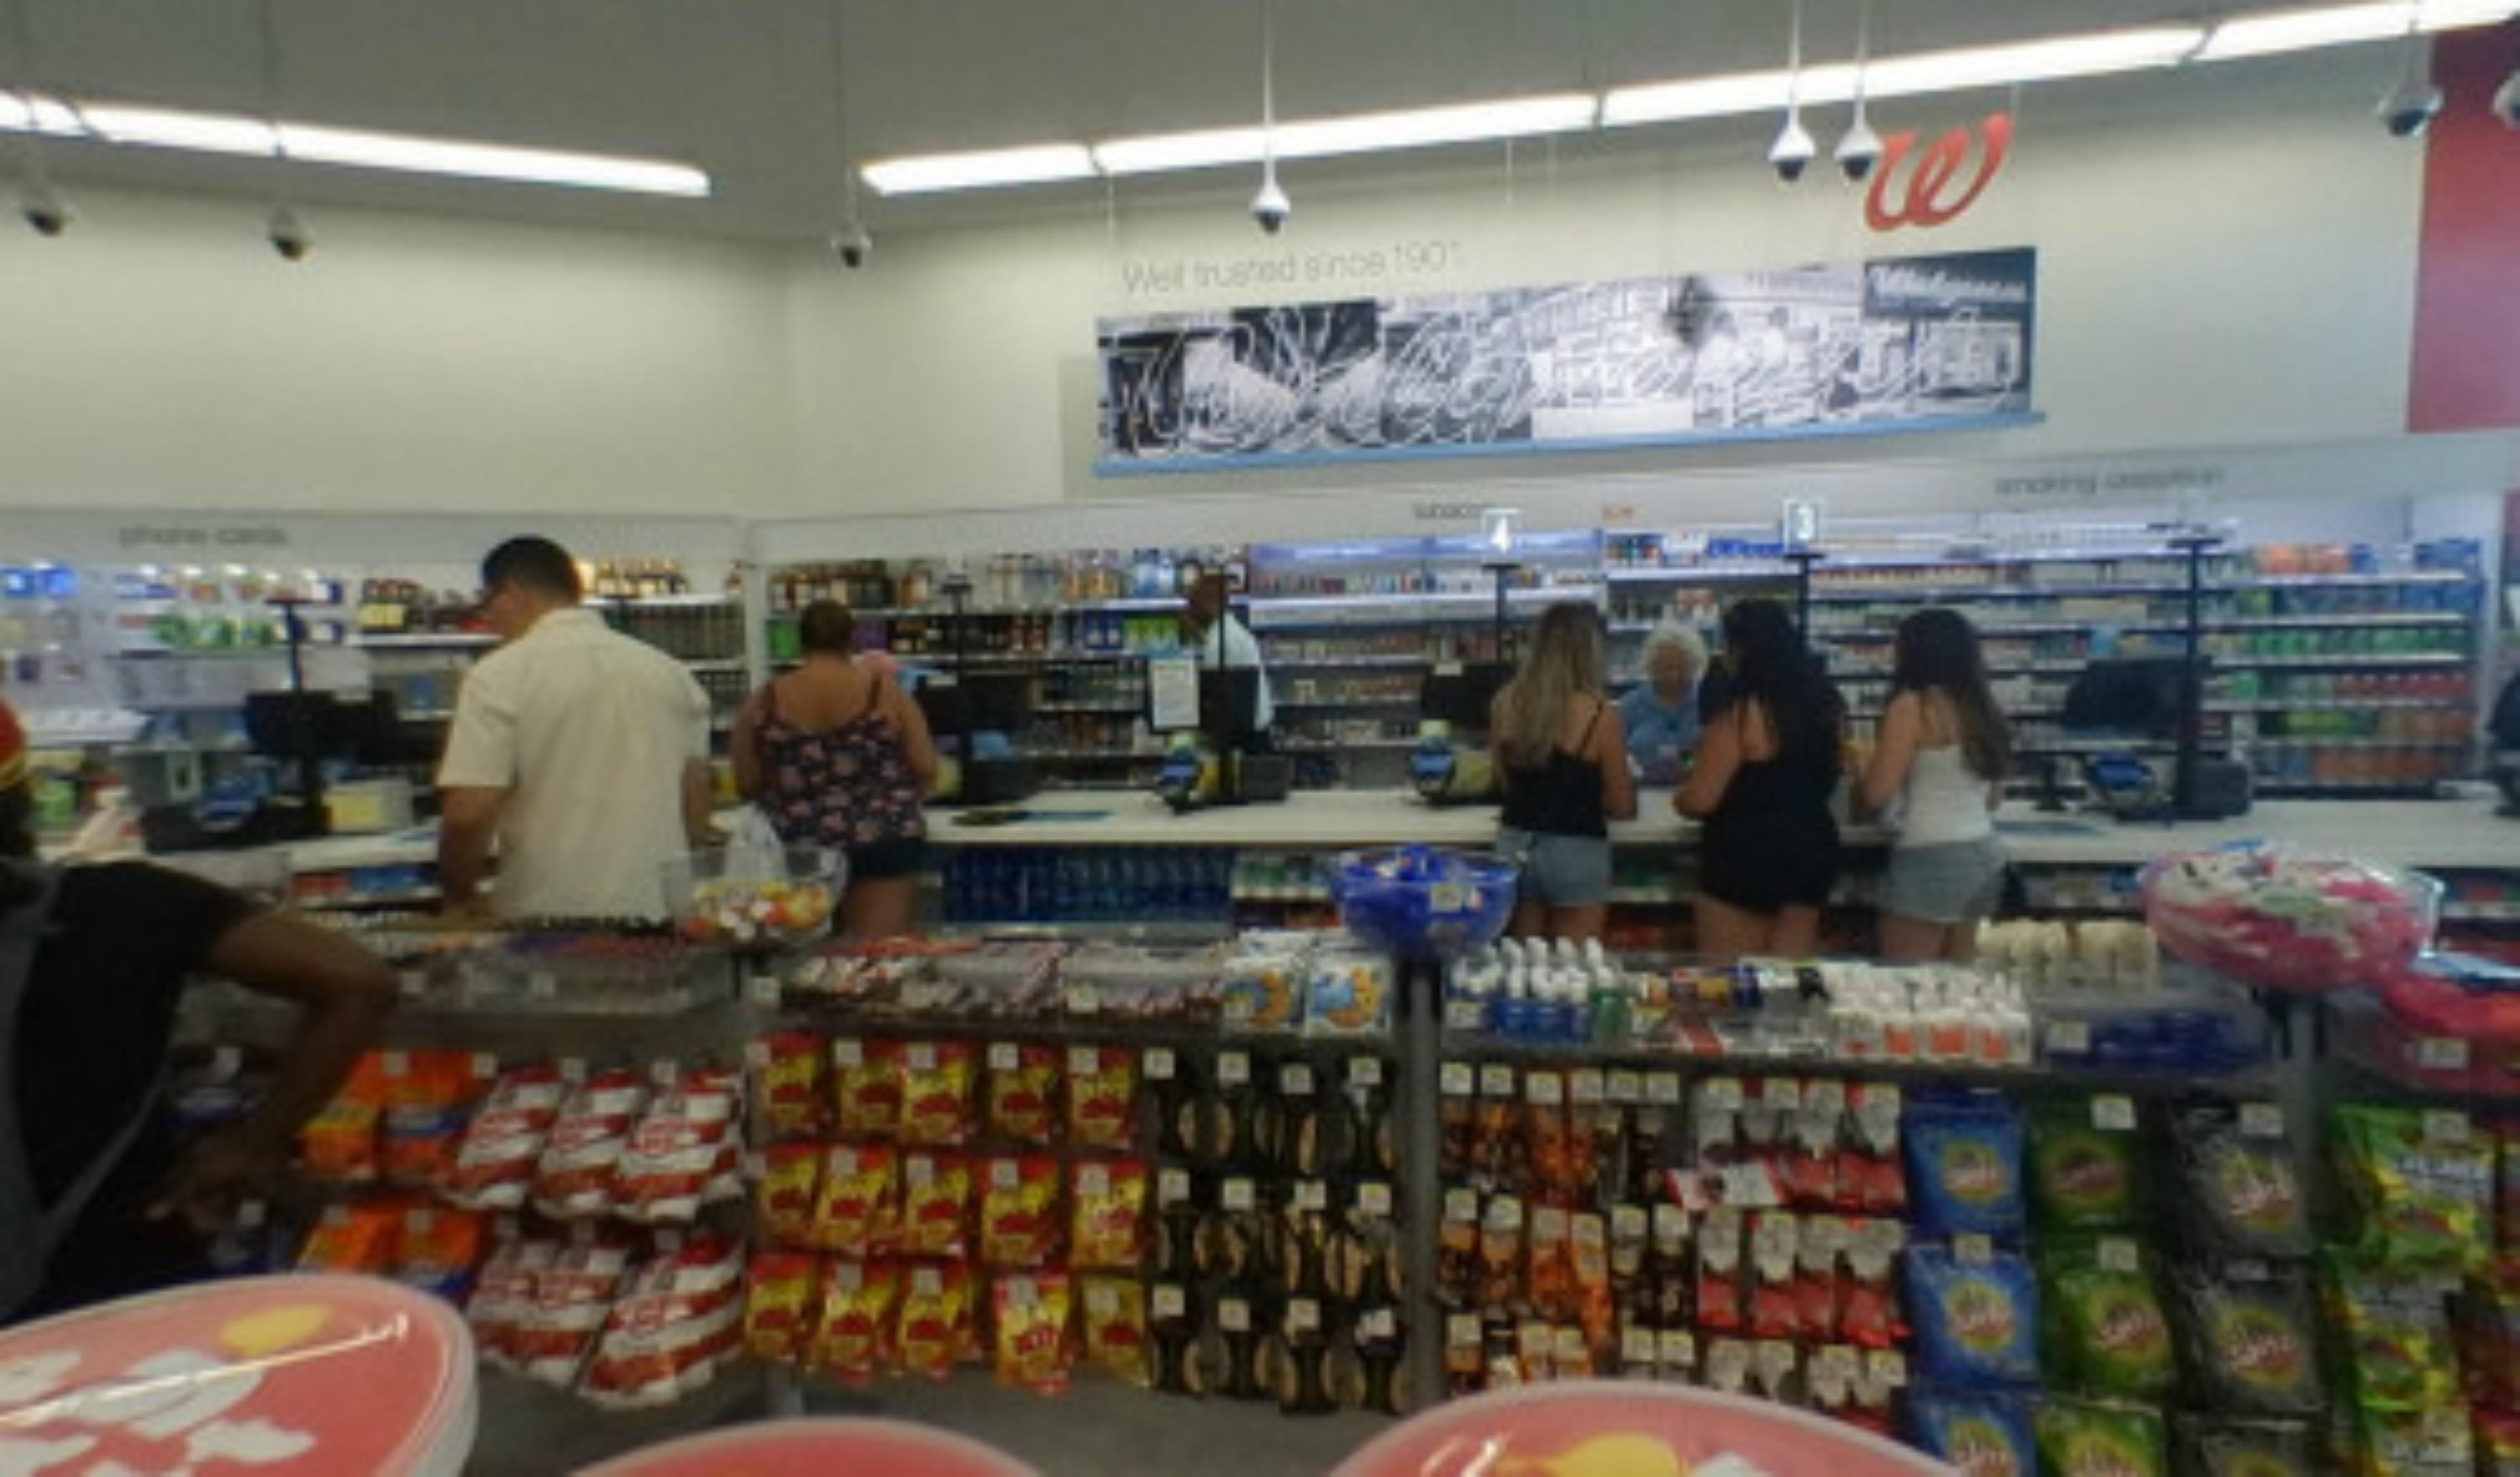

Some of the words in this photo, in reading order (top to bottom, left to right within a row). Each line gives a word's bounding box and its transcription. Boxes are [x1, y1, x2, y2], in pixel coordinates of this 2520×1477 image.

[1123, 259, 1186, 294] Well
[1194, 254, 1295, 287] trusted
[1307, 249, 1385, 282] since
